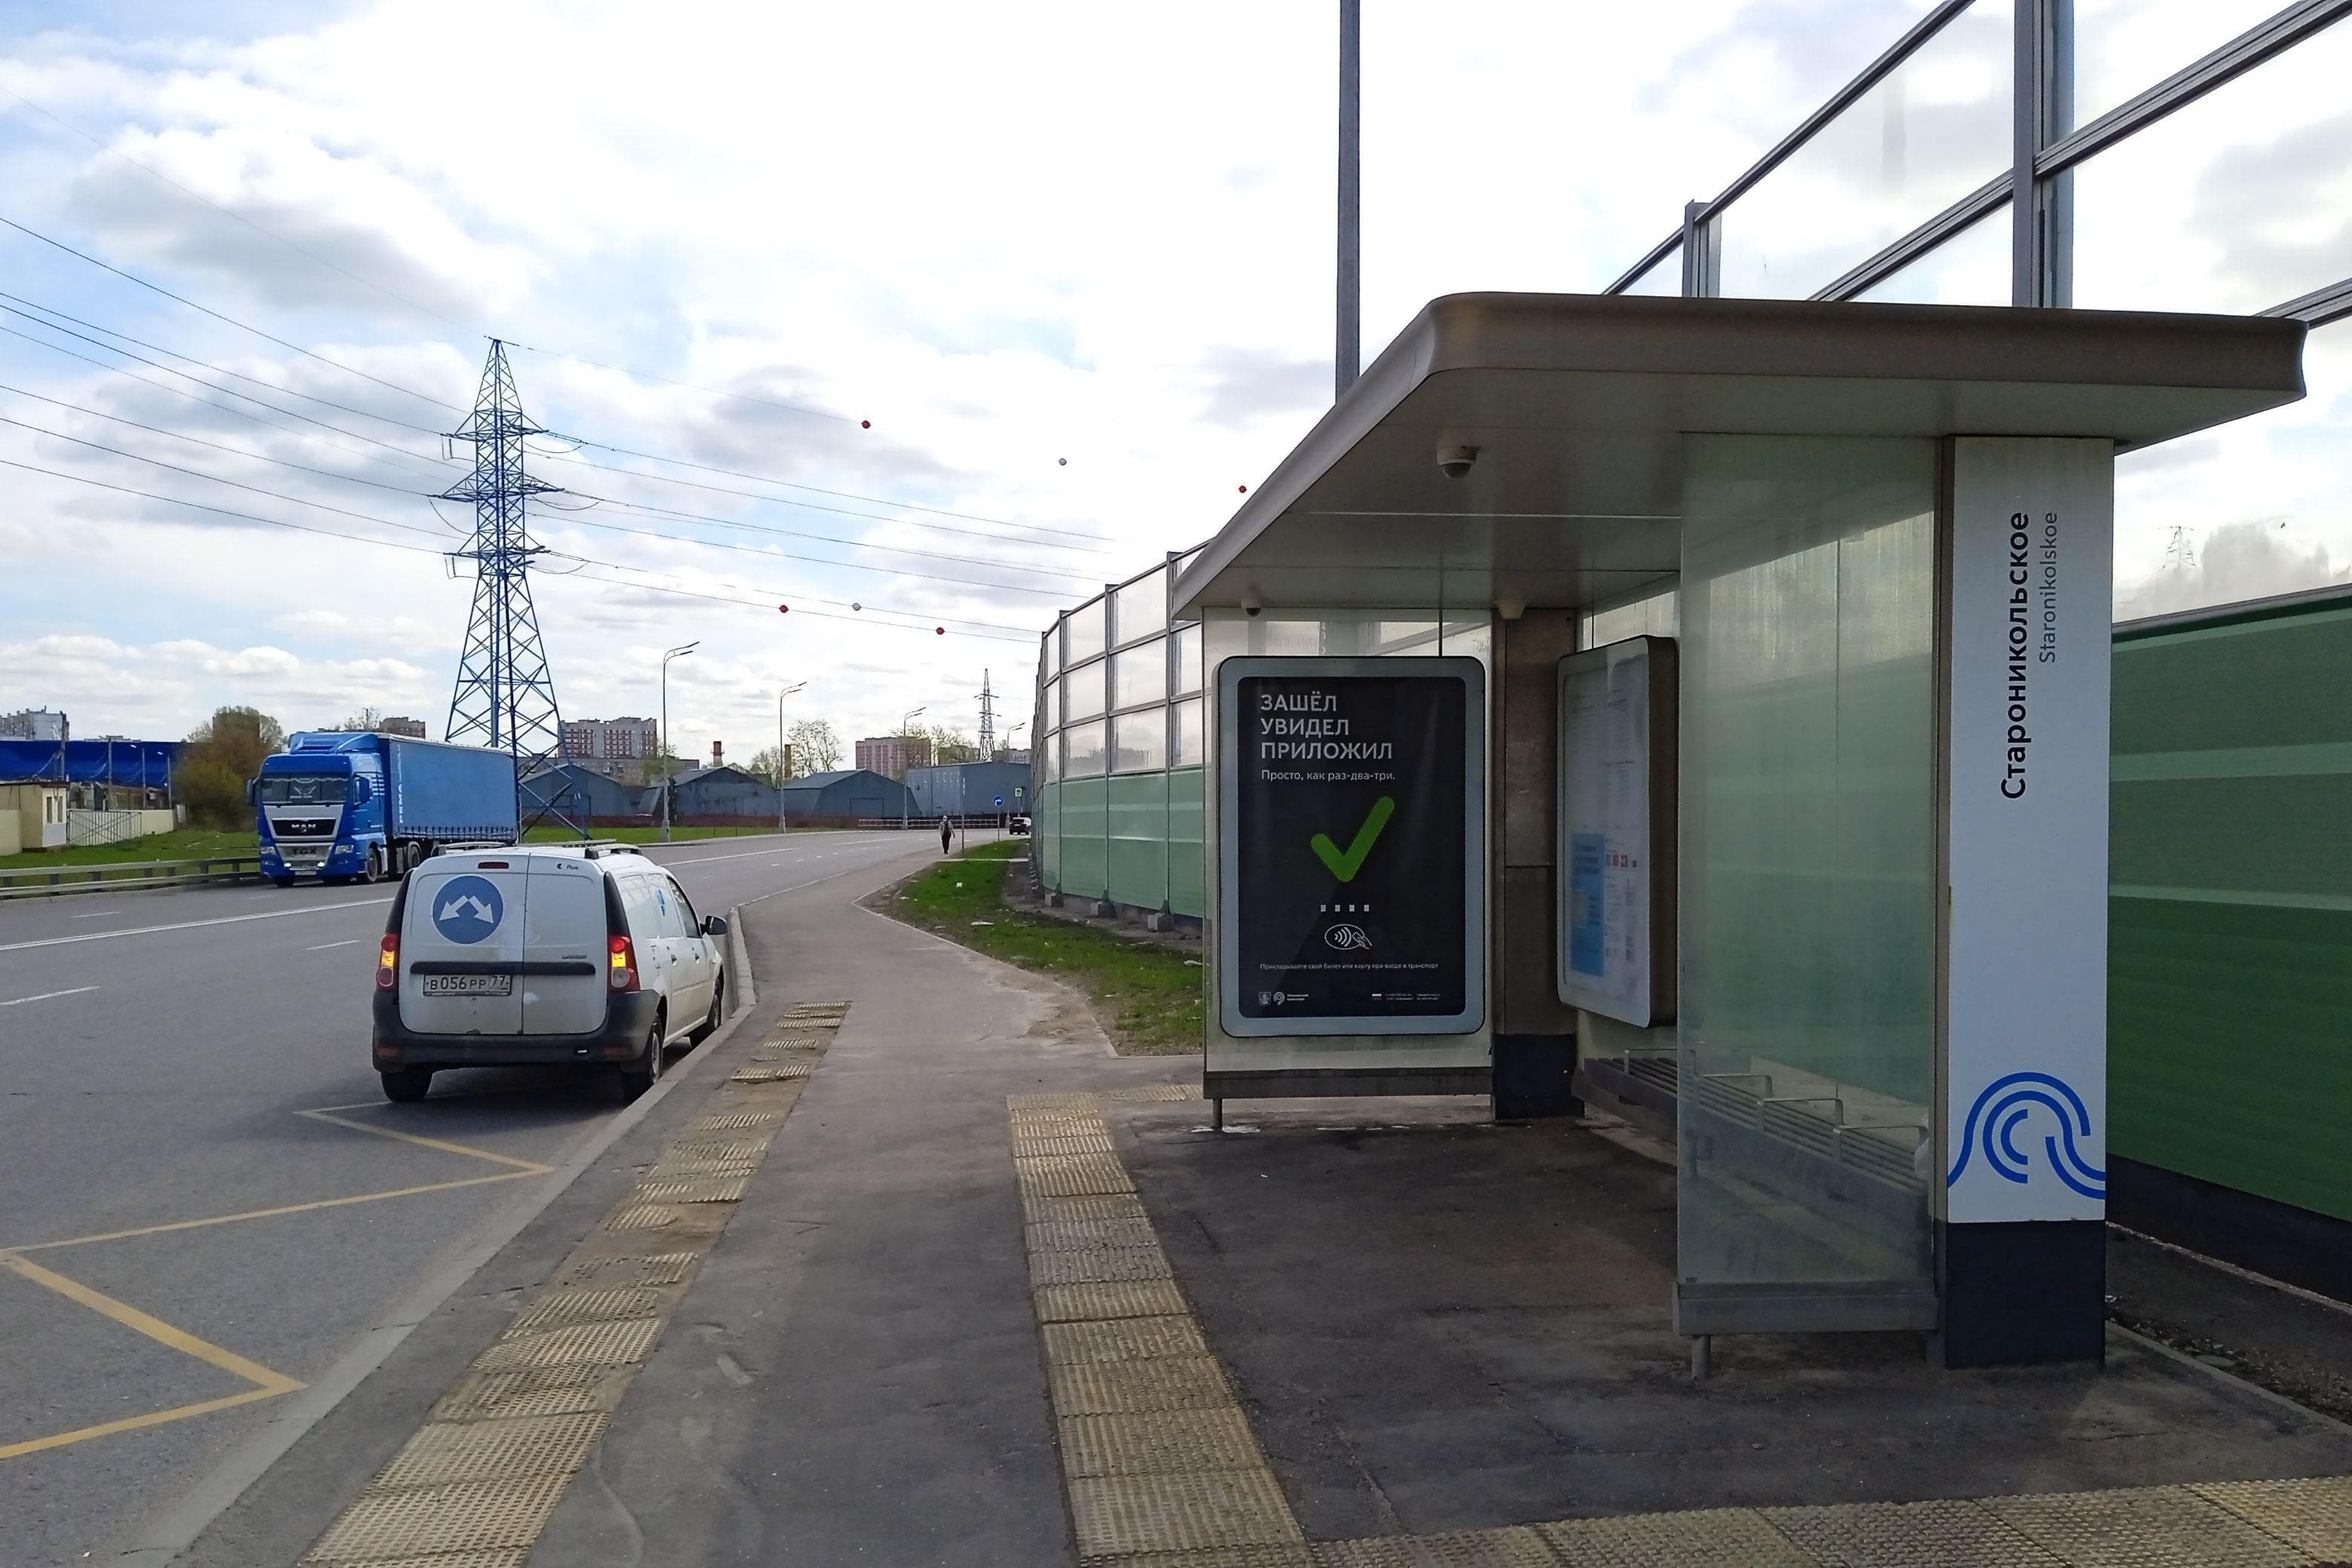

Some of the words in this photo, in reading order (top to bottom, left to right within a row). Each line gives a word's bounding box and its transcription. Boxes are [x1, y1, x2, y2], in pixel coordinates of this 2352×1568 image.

[2039, 512, 2057, 663] Staronikolskoe
[2001, 512, 2032, 799] Староникольское
[1260, 691, 1337, 712] ЗАШЁЛ
[1260, 718, 1349, 738] УВИДЕЛ
[1261, 742, 1392, 760] ПРИЛОЖИЛ
[1261, 770, 1304, 781] Просто,
[1306, 772, 1325, 780] как
[1328, 772, 1395, 782] раз-два-три.
